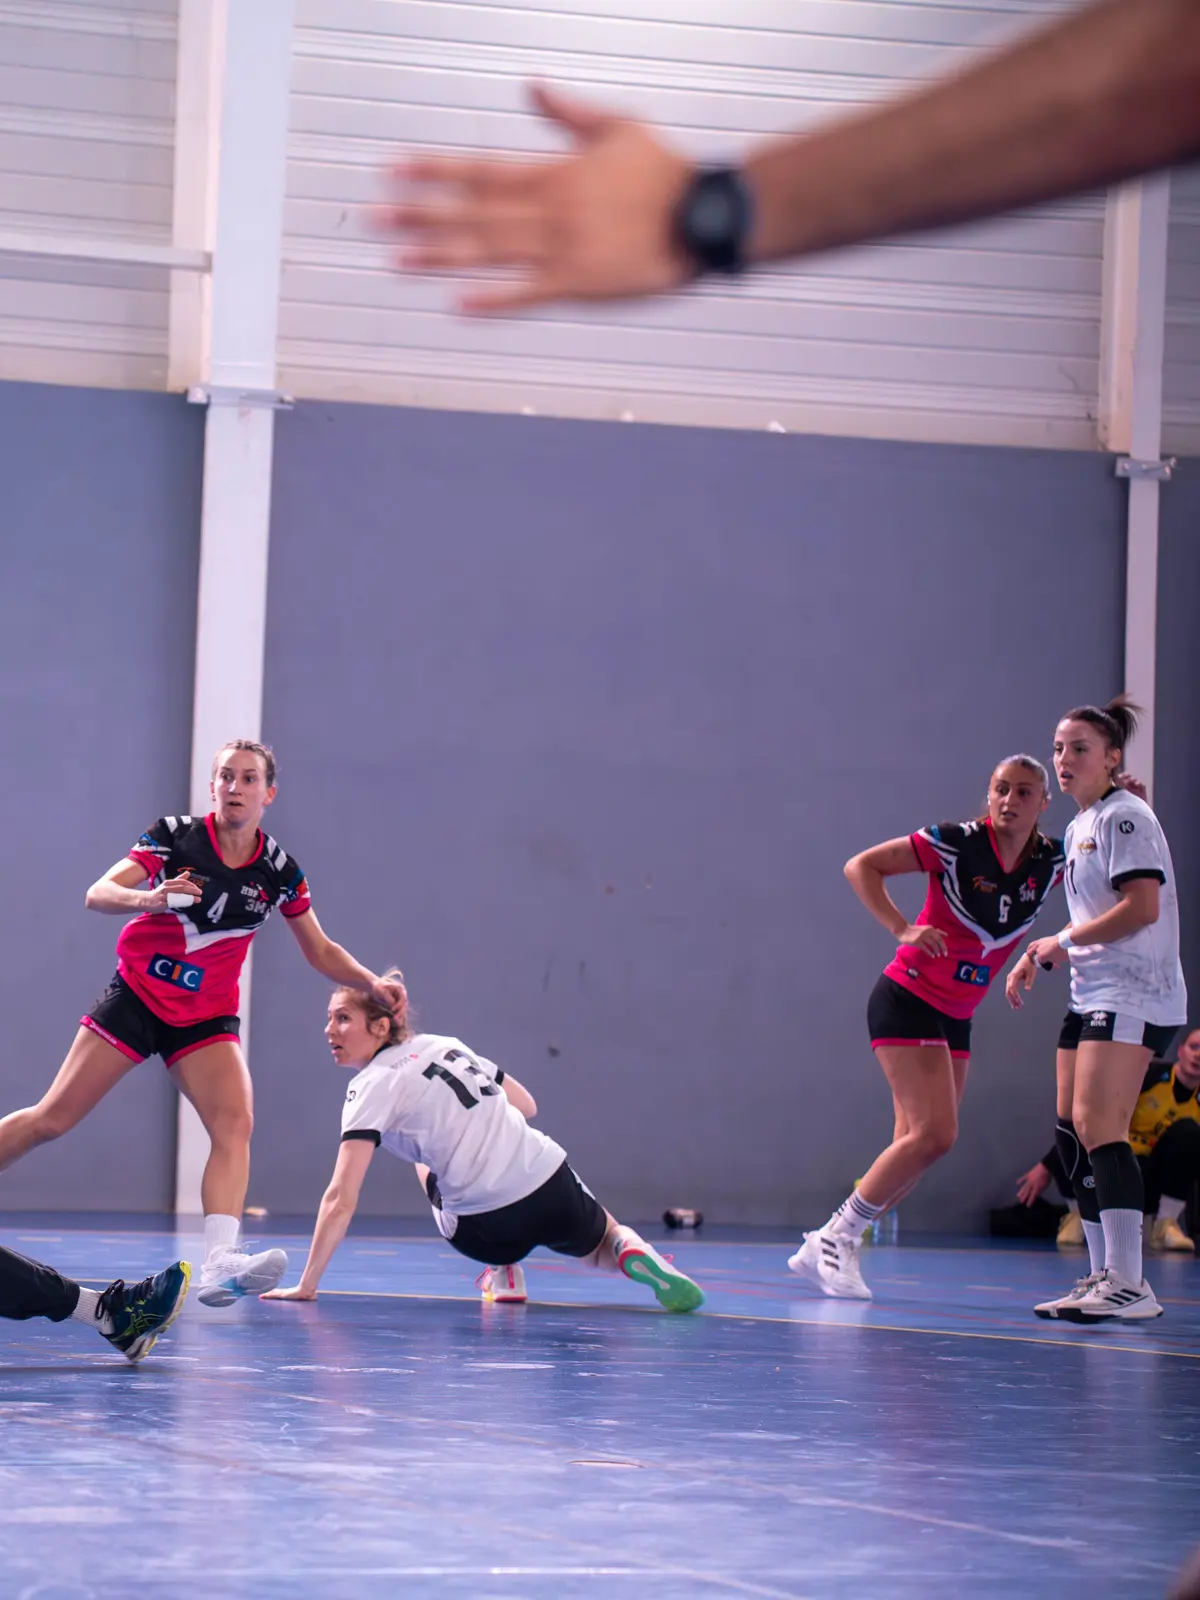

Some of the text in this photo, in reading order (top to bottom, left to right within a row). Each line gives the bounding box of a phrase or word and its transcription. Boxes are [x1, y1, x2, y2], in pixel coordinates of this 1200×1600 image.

[206, 892, 229, 923] 4
[245, 899, 267, 914] 3M
[154, 959, 199, 987] CIC
[422, 1049, 501, 1110] 13
